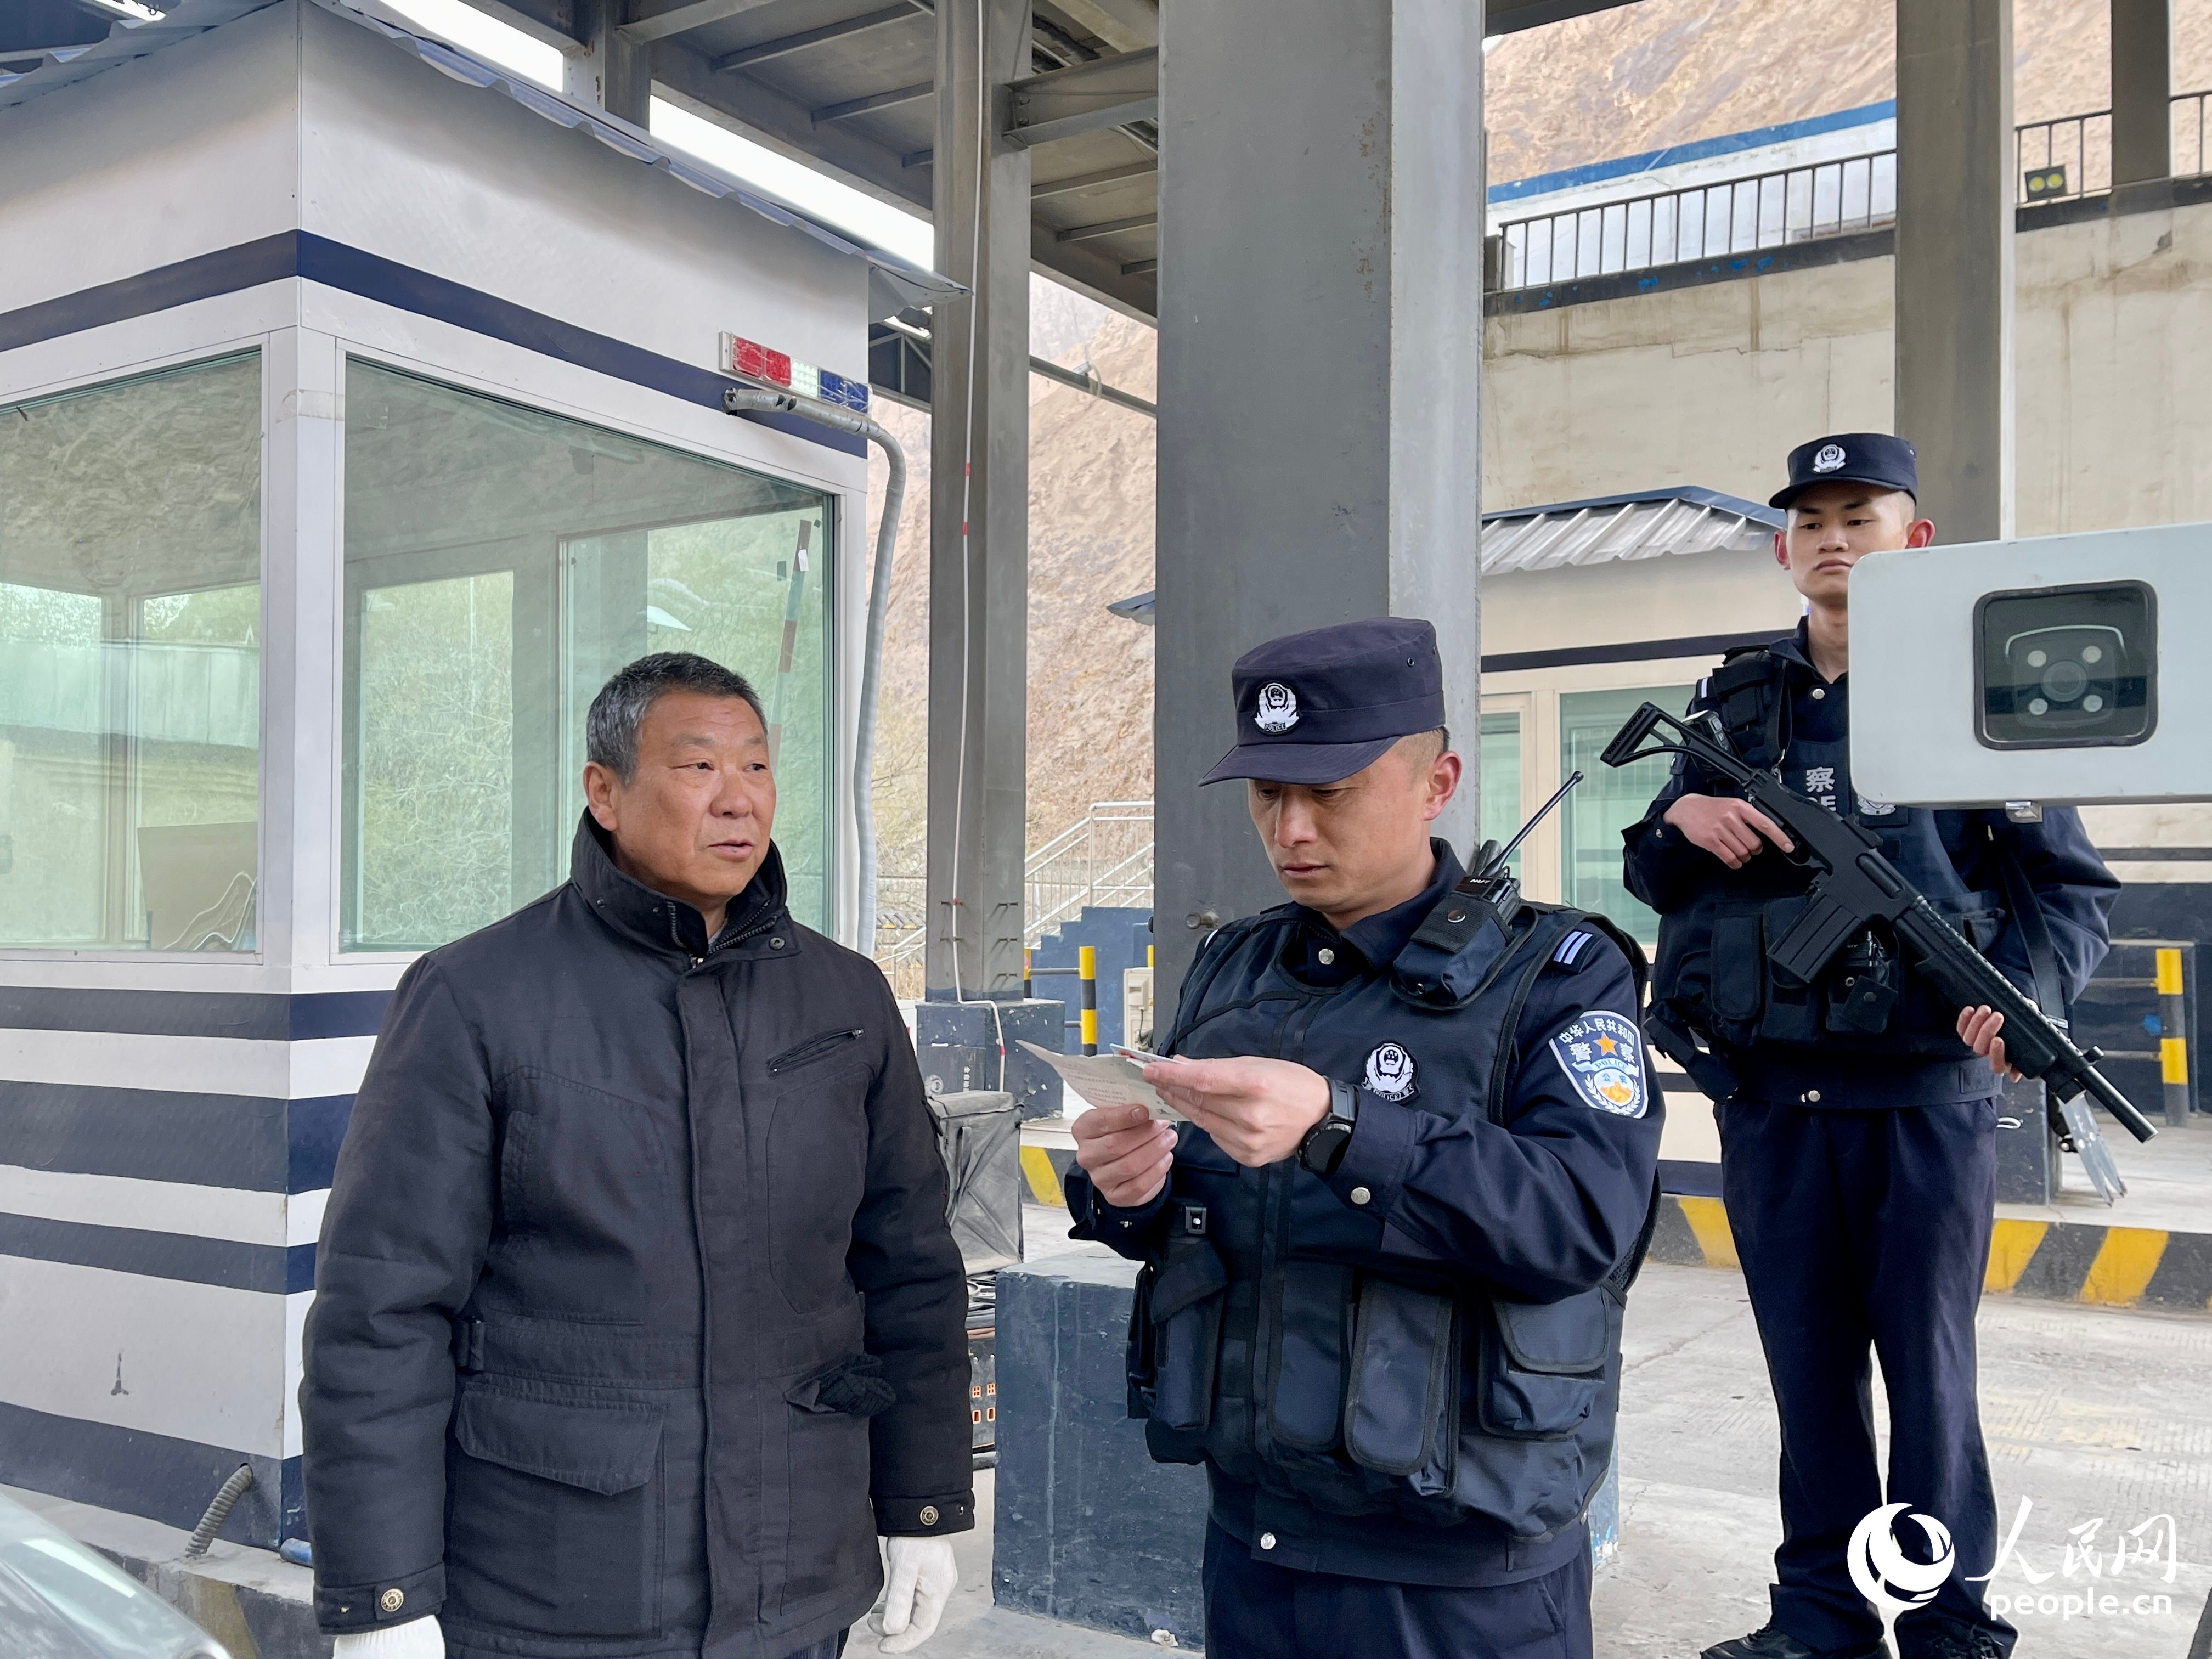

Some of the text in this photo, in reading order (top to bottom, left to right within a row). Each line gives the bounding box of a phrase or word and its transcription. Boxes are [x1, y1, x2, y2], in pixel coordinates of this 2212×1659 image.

[1806, 766, 1835, 793] 察
[1559, 1018, 1635, 1045] 中华人民共和国
[1595, 1060, 1627, 1070] POLICE
